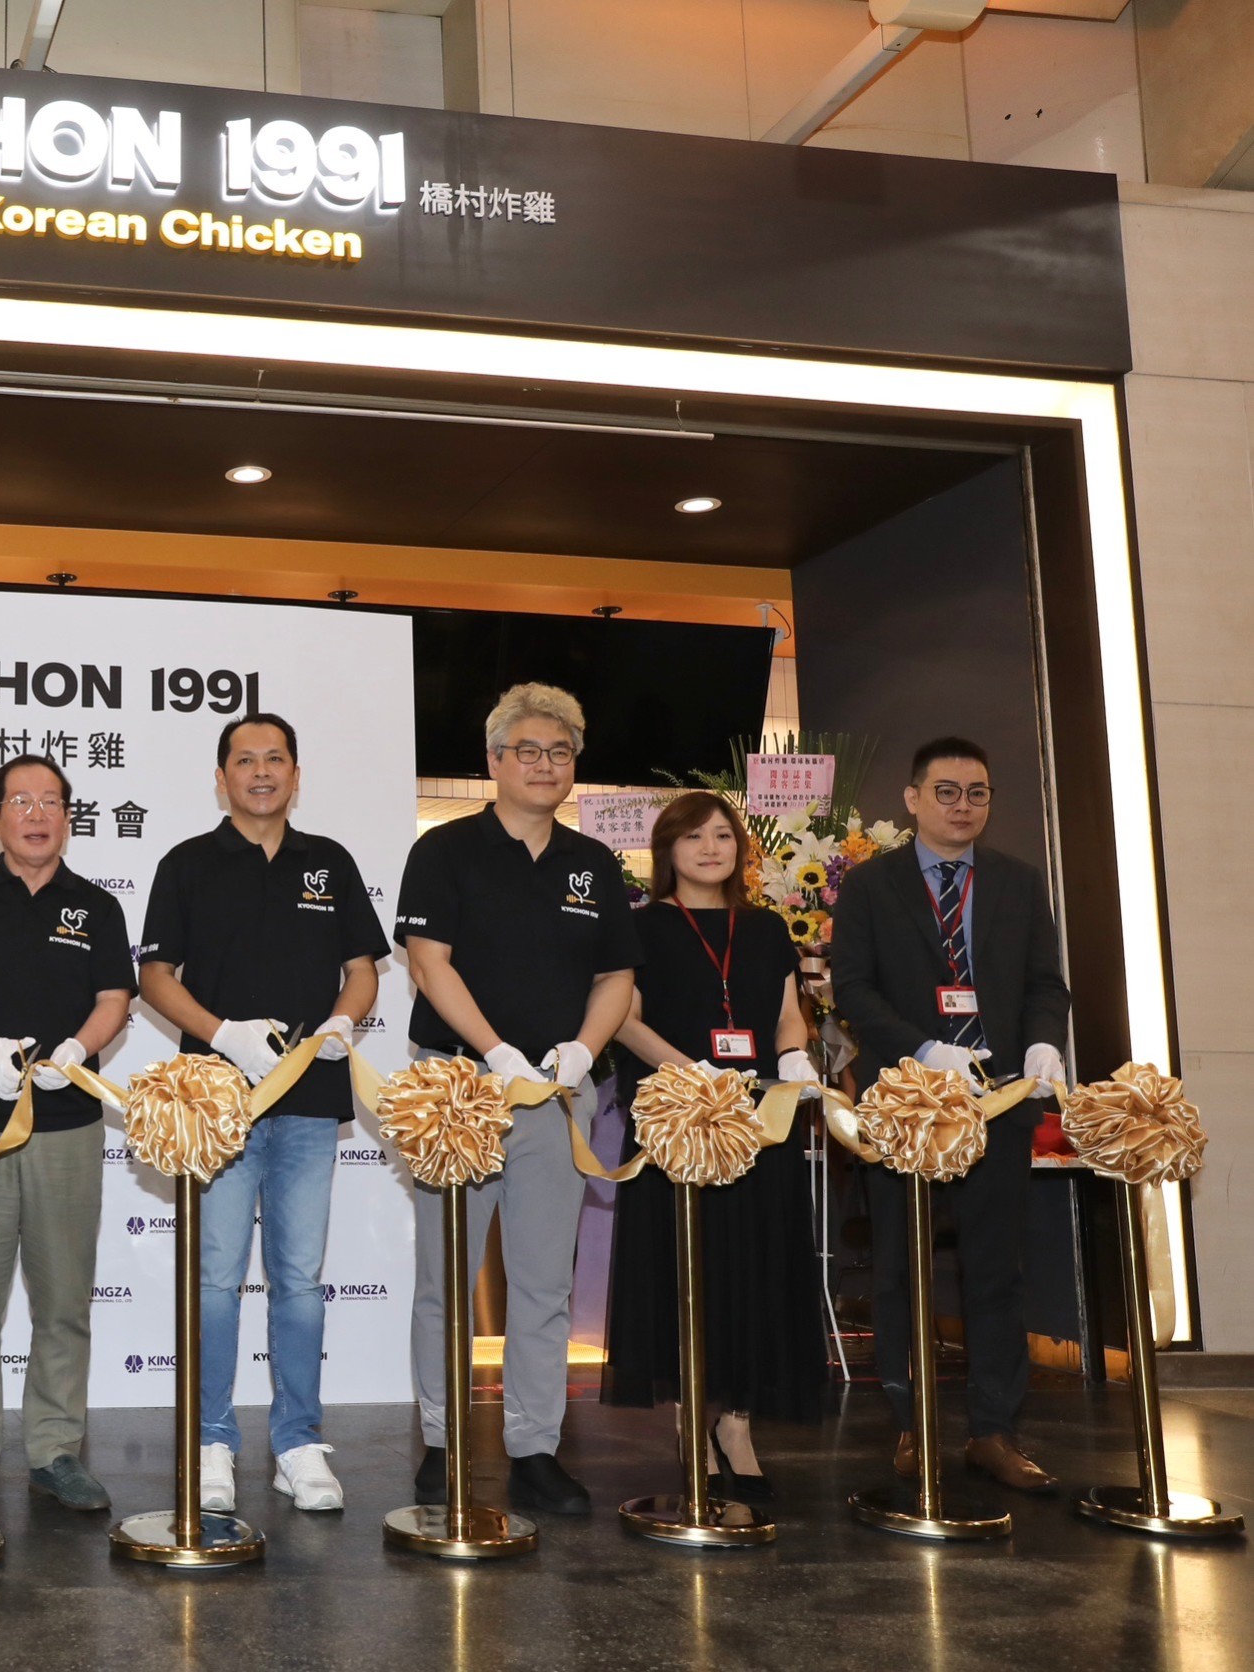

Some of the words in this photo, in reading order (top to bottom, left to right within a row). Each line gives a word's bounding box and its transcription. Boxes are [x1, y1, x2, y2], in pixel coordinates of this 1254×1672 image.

[221, 117, 406, 213] 1991
[418, 180, 557, 225] 橋村炸雞
[159, 208, 363, 263] Chicken
[150, 667, 260, 715] 1991
[408, 916, 427, 926] 1991
[340, 1150, 387, 1161] KINGZA
[91, 1287, 132, 1297] INGZA
[245, 1284, 265, 1293] 1991
[340, 1285, 388, 1295] KINGZA
